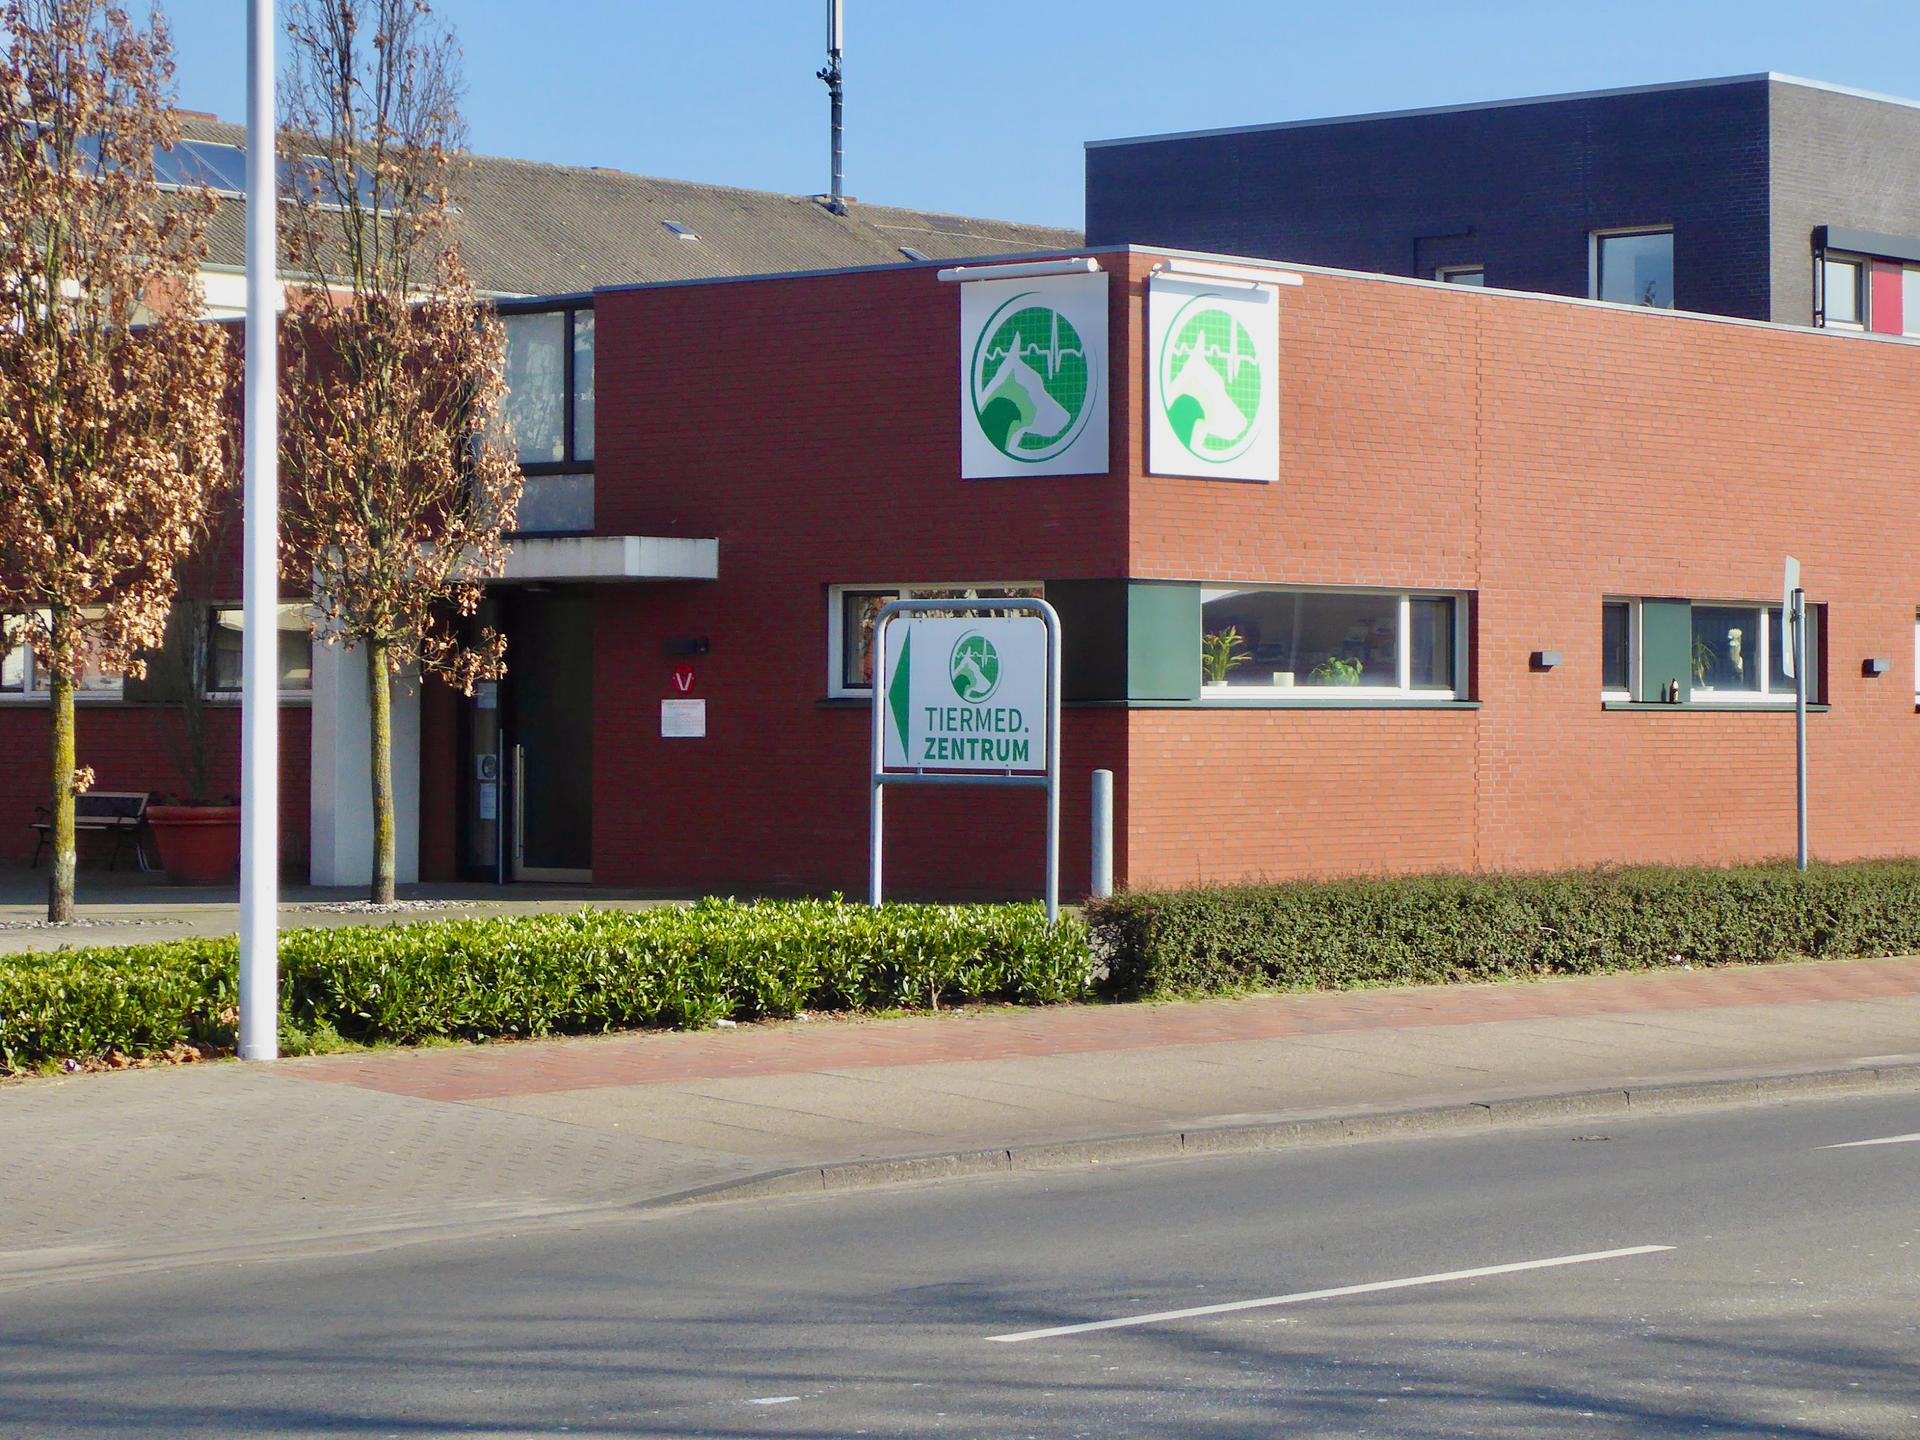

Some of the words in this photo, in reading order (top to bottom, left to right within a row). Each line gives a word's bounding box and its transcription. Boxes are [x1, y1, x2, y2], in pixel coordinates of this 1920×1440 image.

[675, 672, 693, 691] V
[924, 707, 1029, 733] TIERMED.
[924, 737, 1029, 762] ZENTRUM
